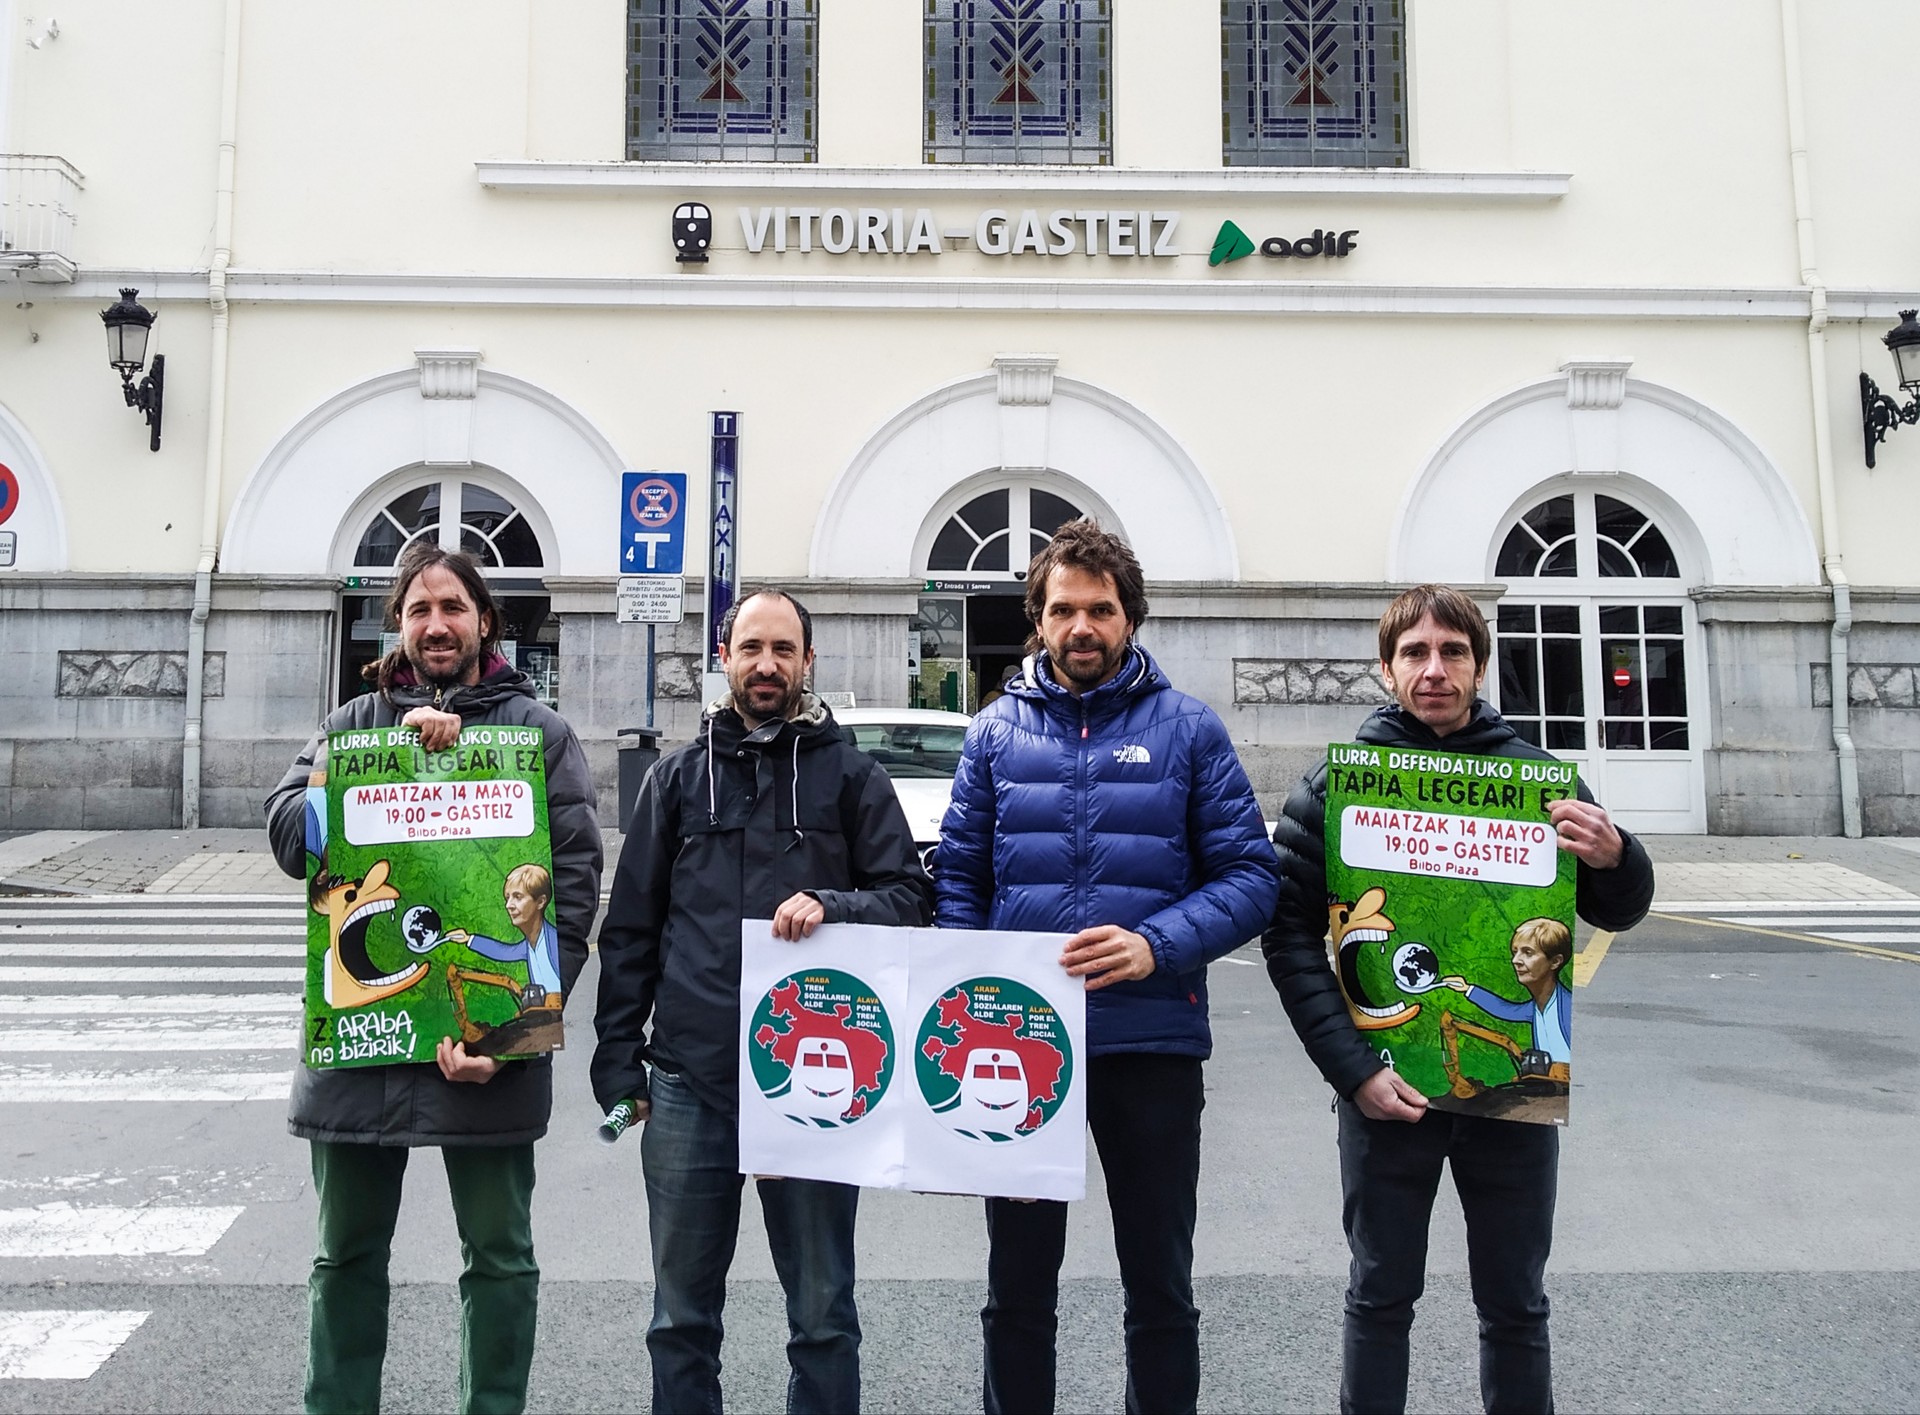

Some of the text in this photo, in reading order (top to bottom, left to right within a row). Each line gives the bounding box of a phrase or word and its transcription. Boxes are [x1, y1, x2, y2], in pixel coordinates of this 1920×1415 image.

[1260, 229, 1359, 258] adif
[717, 415, 733, 433] T
[715, 481, 731, 576] TAXI
[626, 546, 634, 562] 4
[634, 533, 671, 568] T
[333, 730, 540, 751] LURRA DEFEUKO DUGU
[333, 749, 540, 777] TAPIA LEGEARI EZ
[1332, 748, 1573, 784] LURRA DEFENDATUKO DUGU
[357, 783, 524, 805] MAIATZAK 14 MAYO
[1331, 768, 1403, 798] TAPIA
[1418, 777, 1524, 810] LEGEARI
[386, 807, 426, 825] 19:00
[447, 803, 514, 821] GASTEIZ
[407, 825, 472, 838] Bilbo Plaza
[1355, 810, 1546, 844] MAIATZAK 14 MAYO
[1385, 835, 1429, 856] 19:00
[1454, 842, 1530, 866] GASTEIZ
[1409, 858, 1479, 876] Bilbo Plaza
[804, 976, 830, 984] ARABA
[804, 984, 824, 992] TREN
[973, 985, 1000, 993] ARABA
[804, 992, 851, 1002] SOZIALAREN
[856, 1004, 881, 1013] POR EL
[973, 1002, 1023, 1011] SOZIALAREN
[856, 1012, 875, 1020] TREN
[856, 1020, 881, 1028] SOCIAL
[1028, 1030, 1057, 1038] SOCIAL
